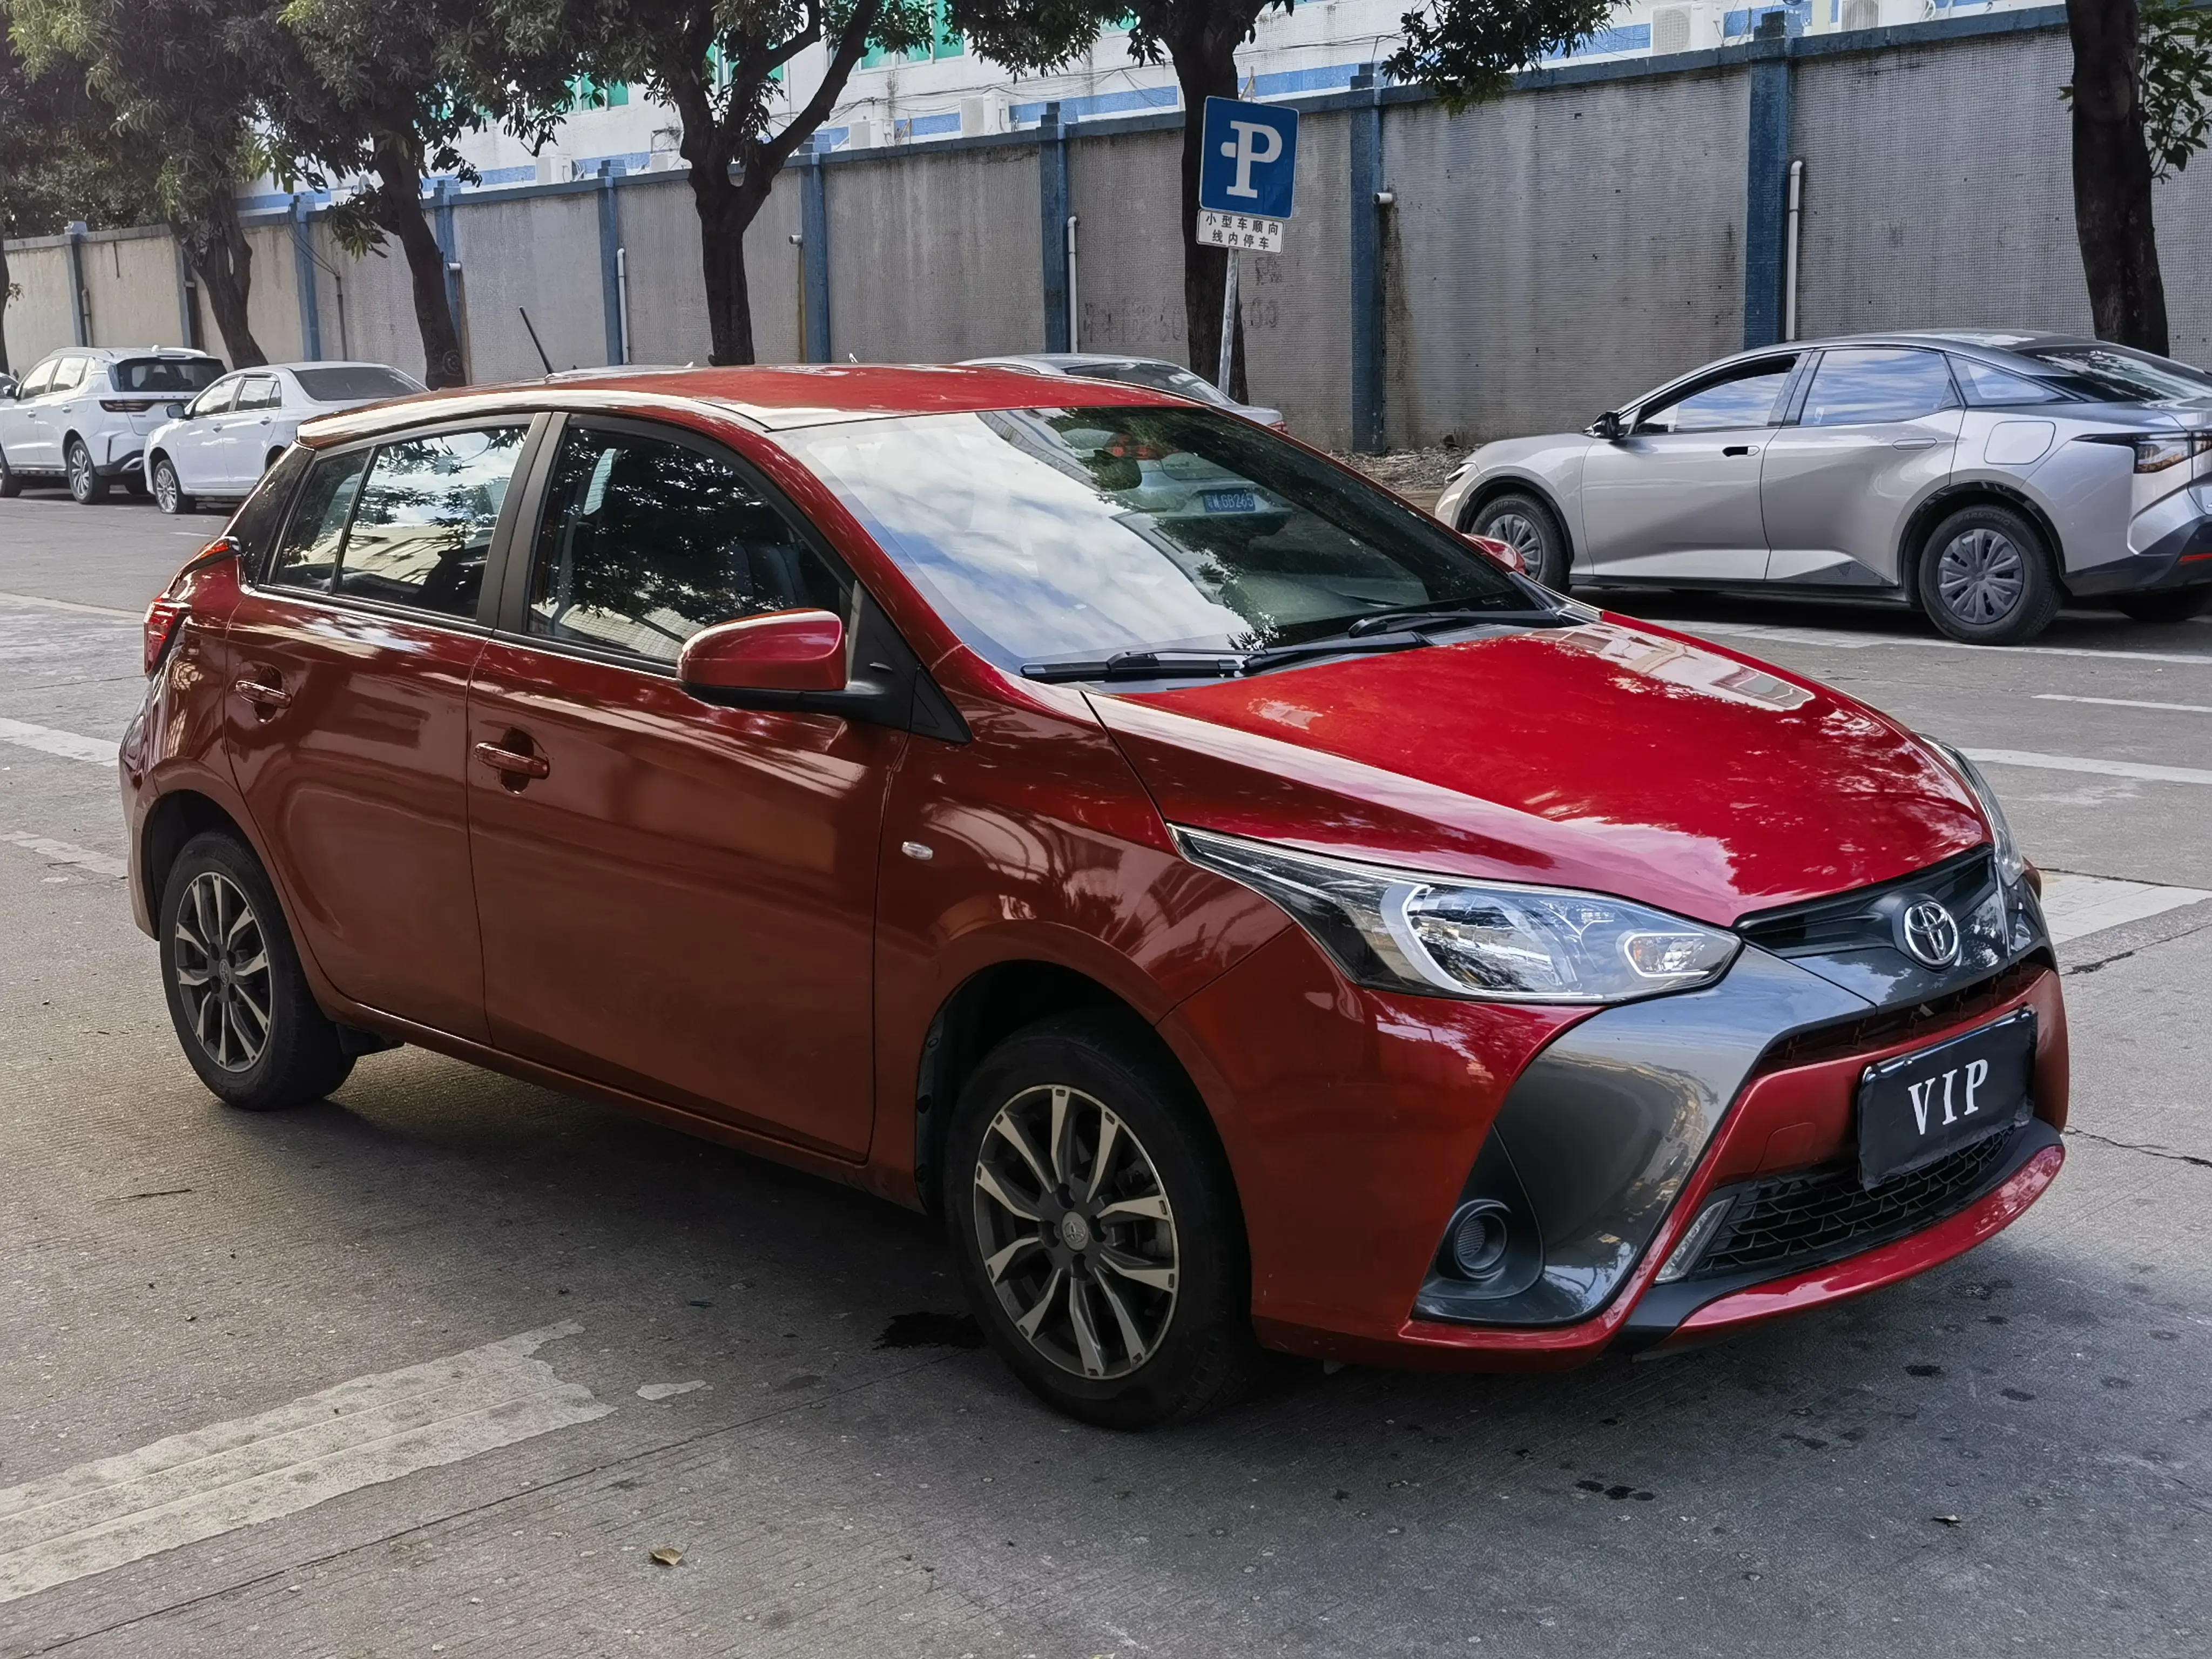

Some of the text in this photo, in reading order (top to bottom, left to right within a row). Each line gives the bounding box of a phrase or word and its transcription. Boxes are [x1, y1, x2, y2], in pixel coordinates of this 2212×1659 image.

[1226, 120, 1283, 199] P
[1205, 213, 1279, 235] 小型车顺向
[1211, 229, 1269, 249] 线内停车
[1907, 1058, 1989, 1136] VIP
